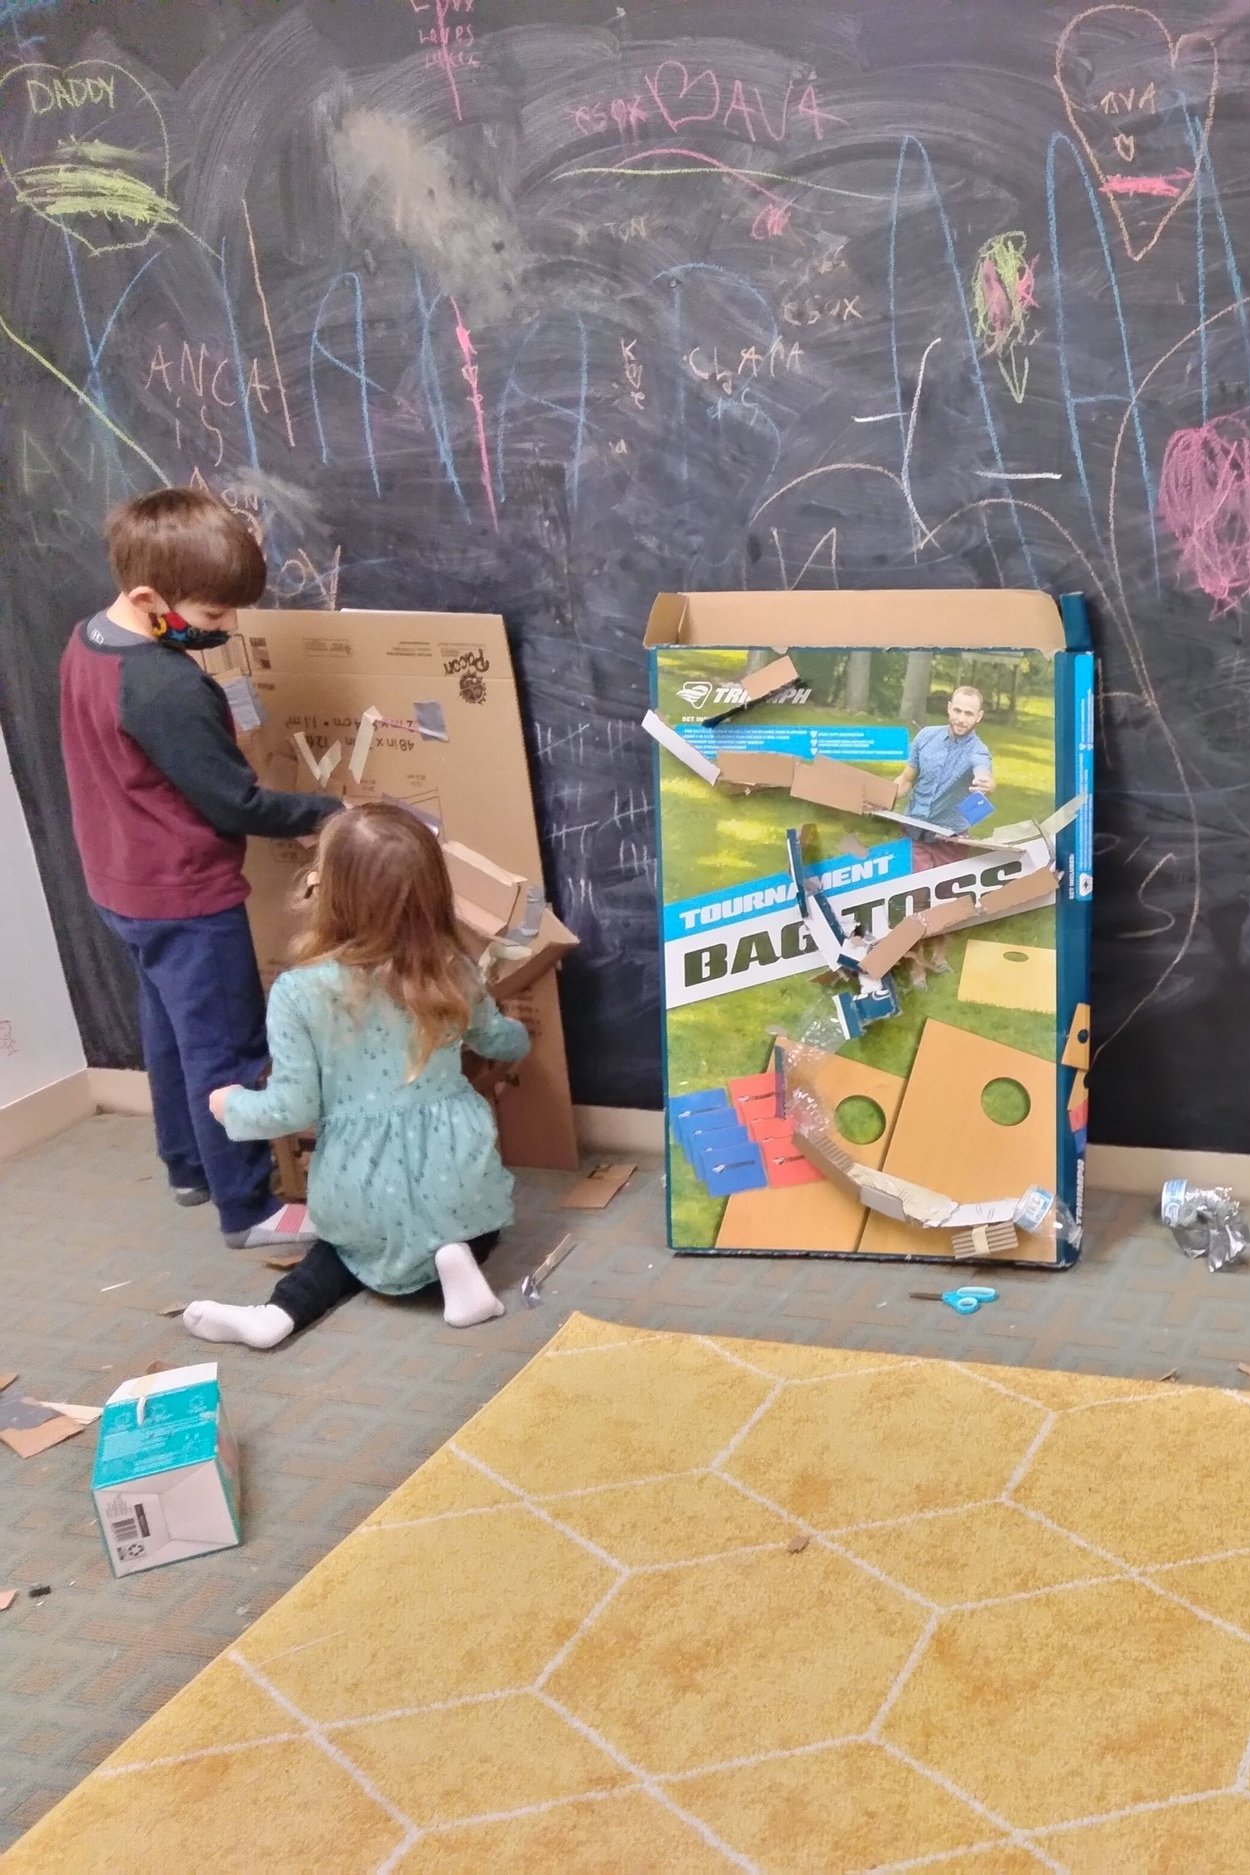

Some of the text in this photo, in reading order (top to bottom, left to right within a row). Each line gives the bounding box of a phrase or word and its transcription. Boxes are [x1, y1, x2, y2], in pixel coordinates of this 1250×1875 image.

[26, 75, 116, 115] DADDY
[443, 648, 490, 676] Pacon
[713, 688, 812, 704] TRIPH
[683, 919, 820, 988] BAG
